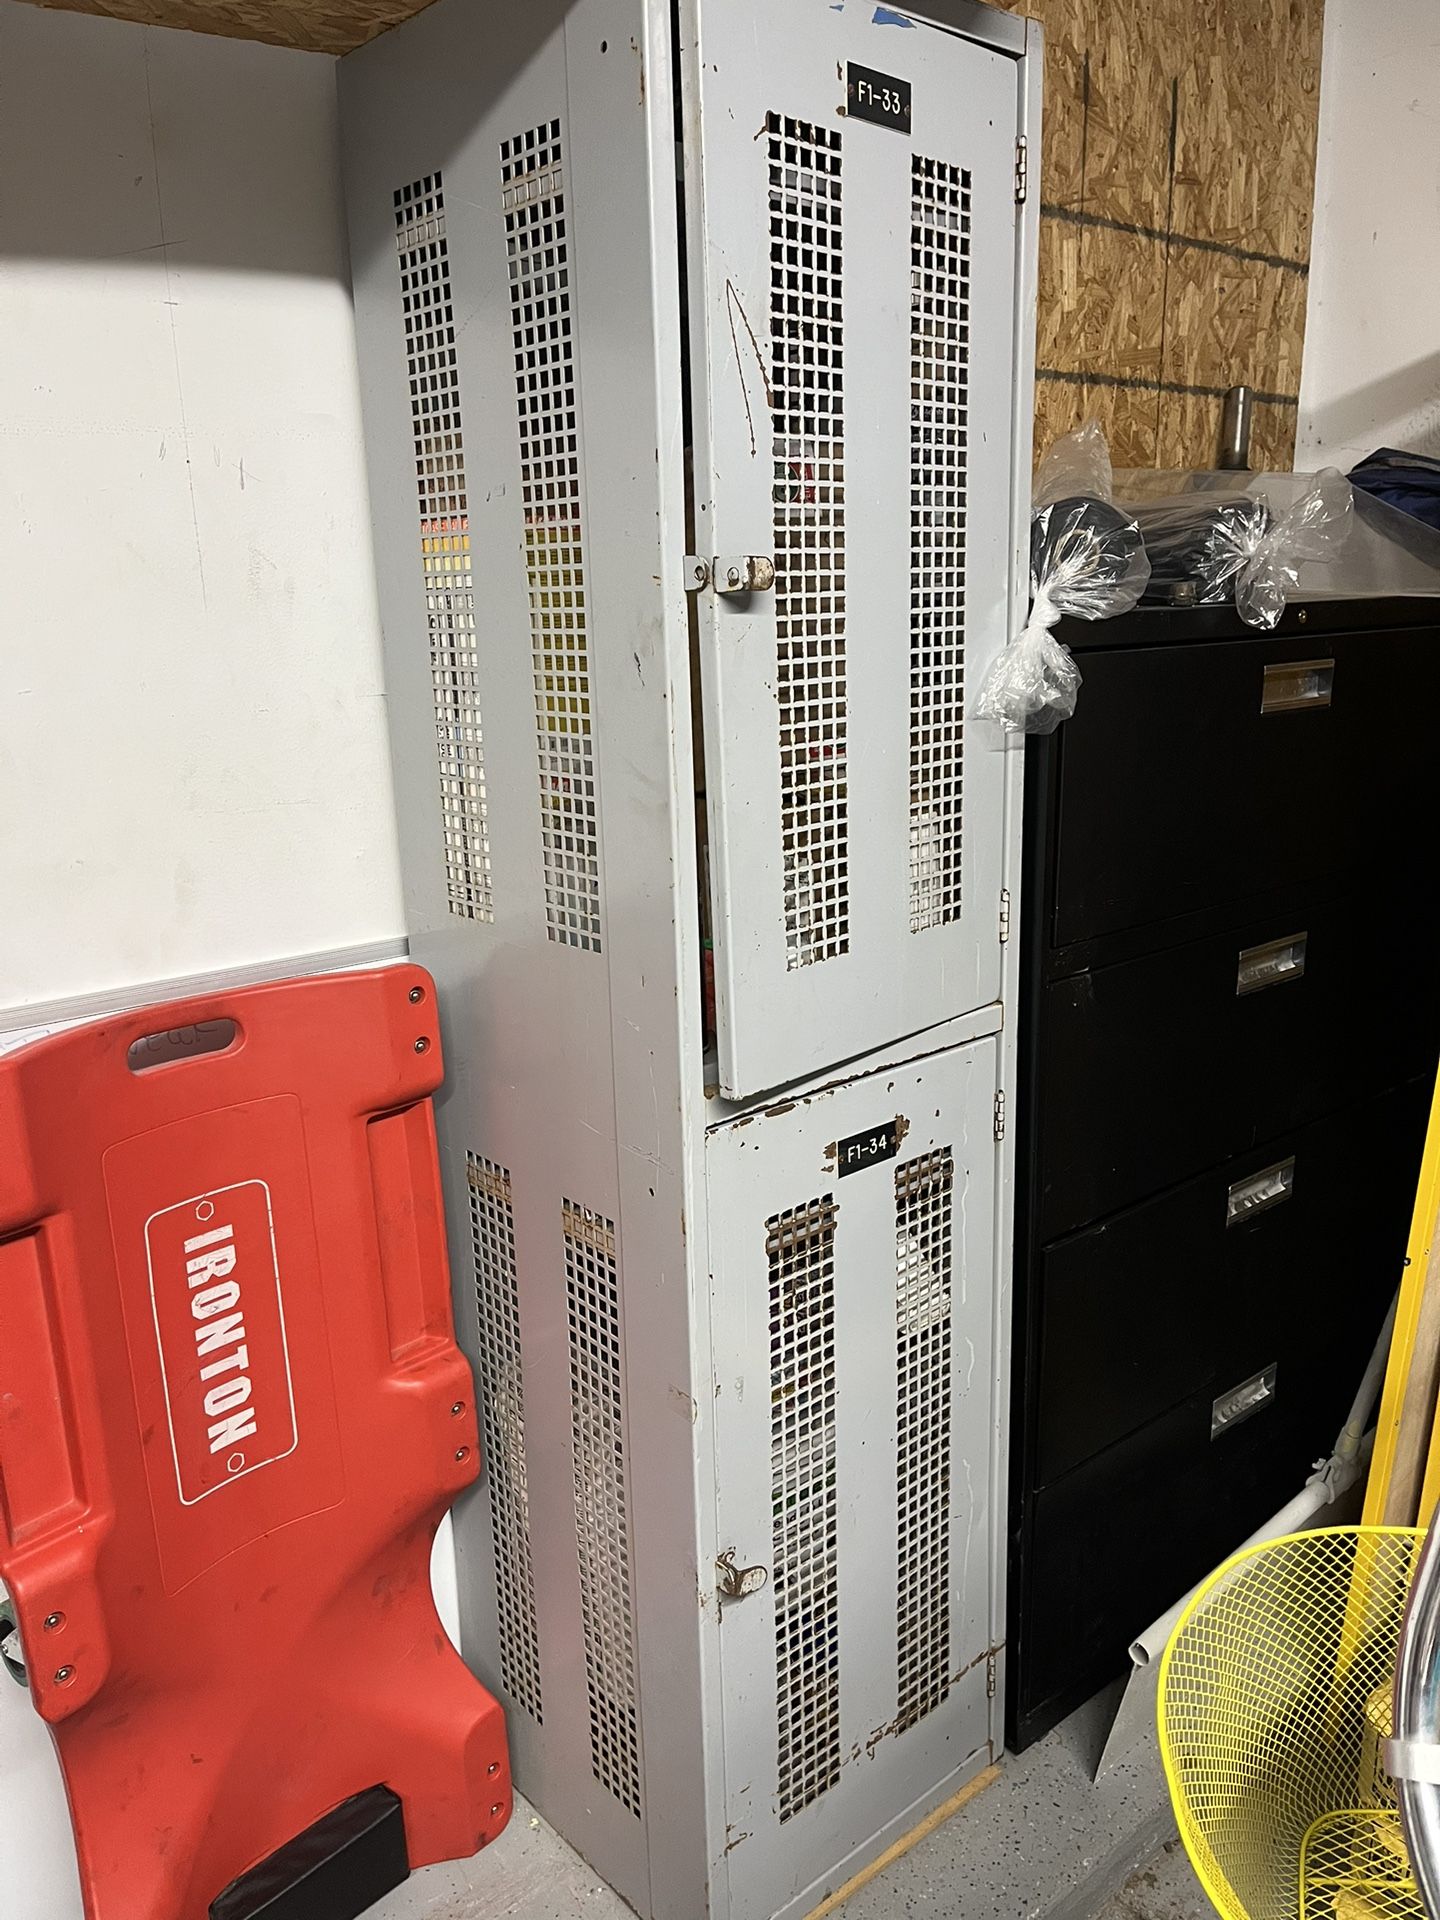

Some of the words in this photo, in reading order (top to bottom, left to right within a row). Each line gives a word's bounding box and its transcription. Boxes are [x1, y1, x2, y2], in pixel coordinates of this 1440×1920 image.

[858, 80, 901, 114] F1-33
[847, 1134, 887, 1163] F1-34
[184, 1224, 257, 1454] IRONTON
